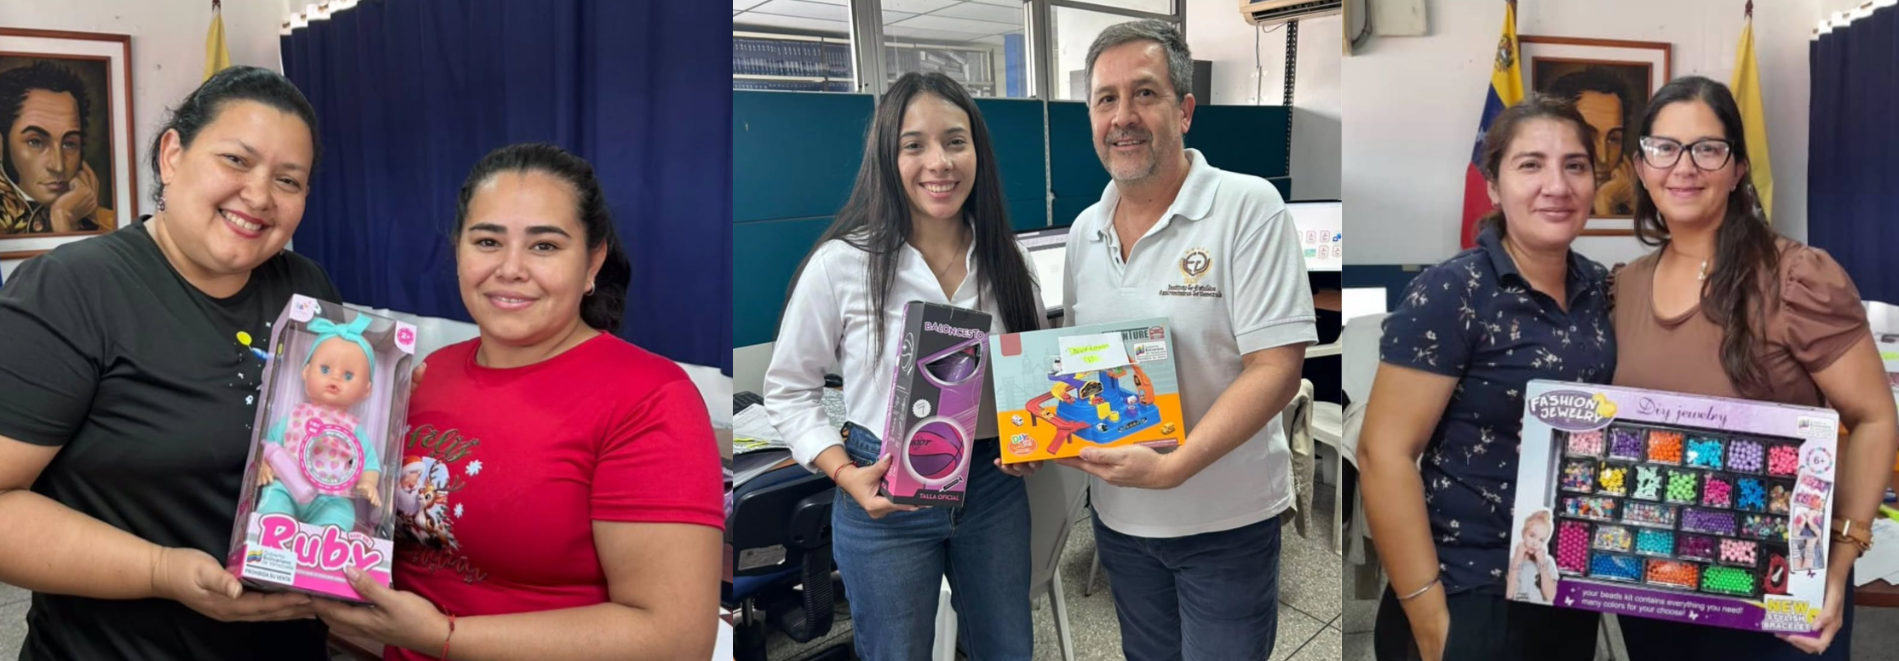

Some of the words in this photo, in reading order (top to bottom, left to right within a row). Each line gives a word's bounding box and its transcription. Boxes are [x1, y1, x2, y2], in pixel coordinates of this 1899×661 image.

[924, 321, 985, 340] BALONCESTO
[1530, 394, 1597, 412] FASHION
[1637, 397, 1670, 416] Diy
[1674, 402, 1728, 425] jewelry
[1540, 406, 1604, 423] JEWELRY
[1012, 433, 1028, 445] DIY
[1814, 455, 1825, 465] 6+
[260, 514, 382, 570] Ruby
[244, 568, 270, 578] PROHIBIDA
[277, 574, 292, 583] VENTA
[1581, 598, 1601, 608] many
[1603, 600, 1625, 610] colors
[1627, 603, 1636, 611] for
[1638, 606, 1655, 615] your
[1656, 606, 1685, 617] choose!
[1582, 588, 1599, 597] your
[1600, 592, 1622, 601] beads
[1624, 593, 1633, 601] kit
[1635, 595, 1665, 606] contains
[1667, 599, 1705, 612] everything
[1707, 603, 1721, 612] you
[1722, 604, 1744, 614] need!
[1767, 598, 1809, 614] NEW
[1766, 613, 1805, 623] STYLISH
